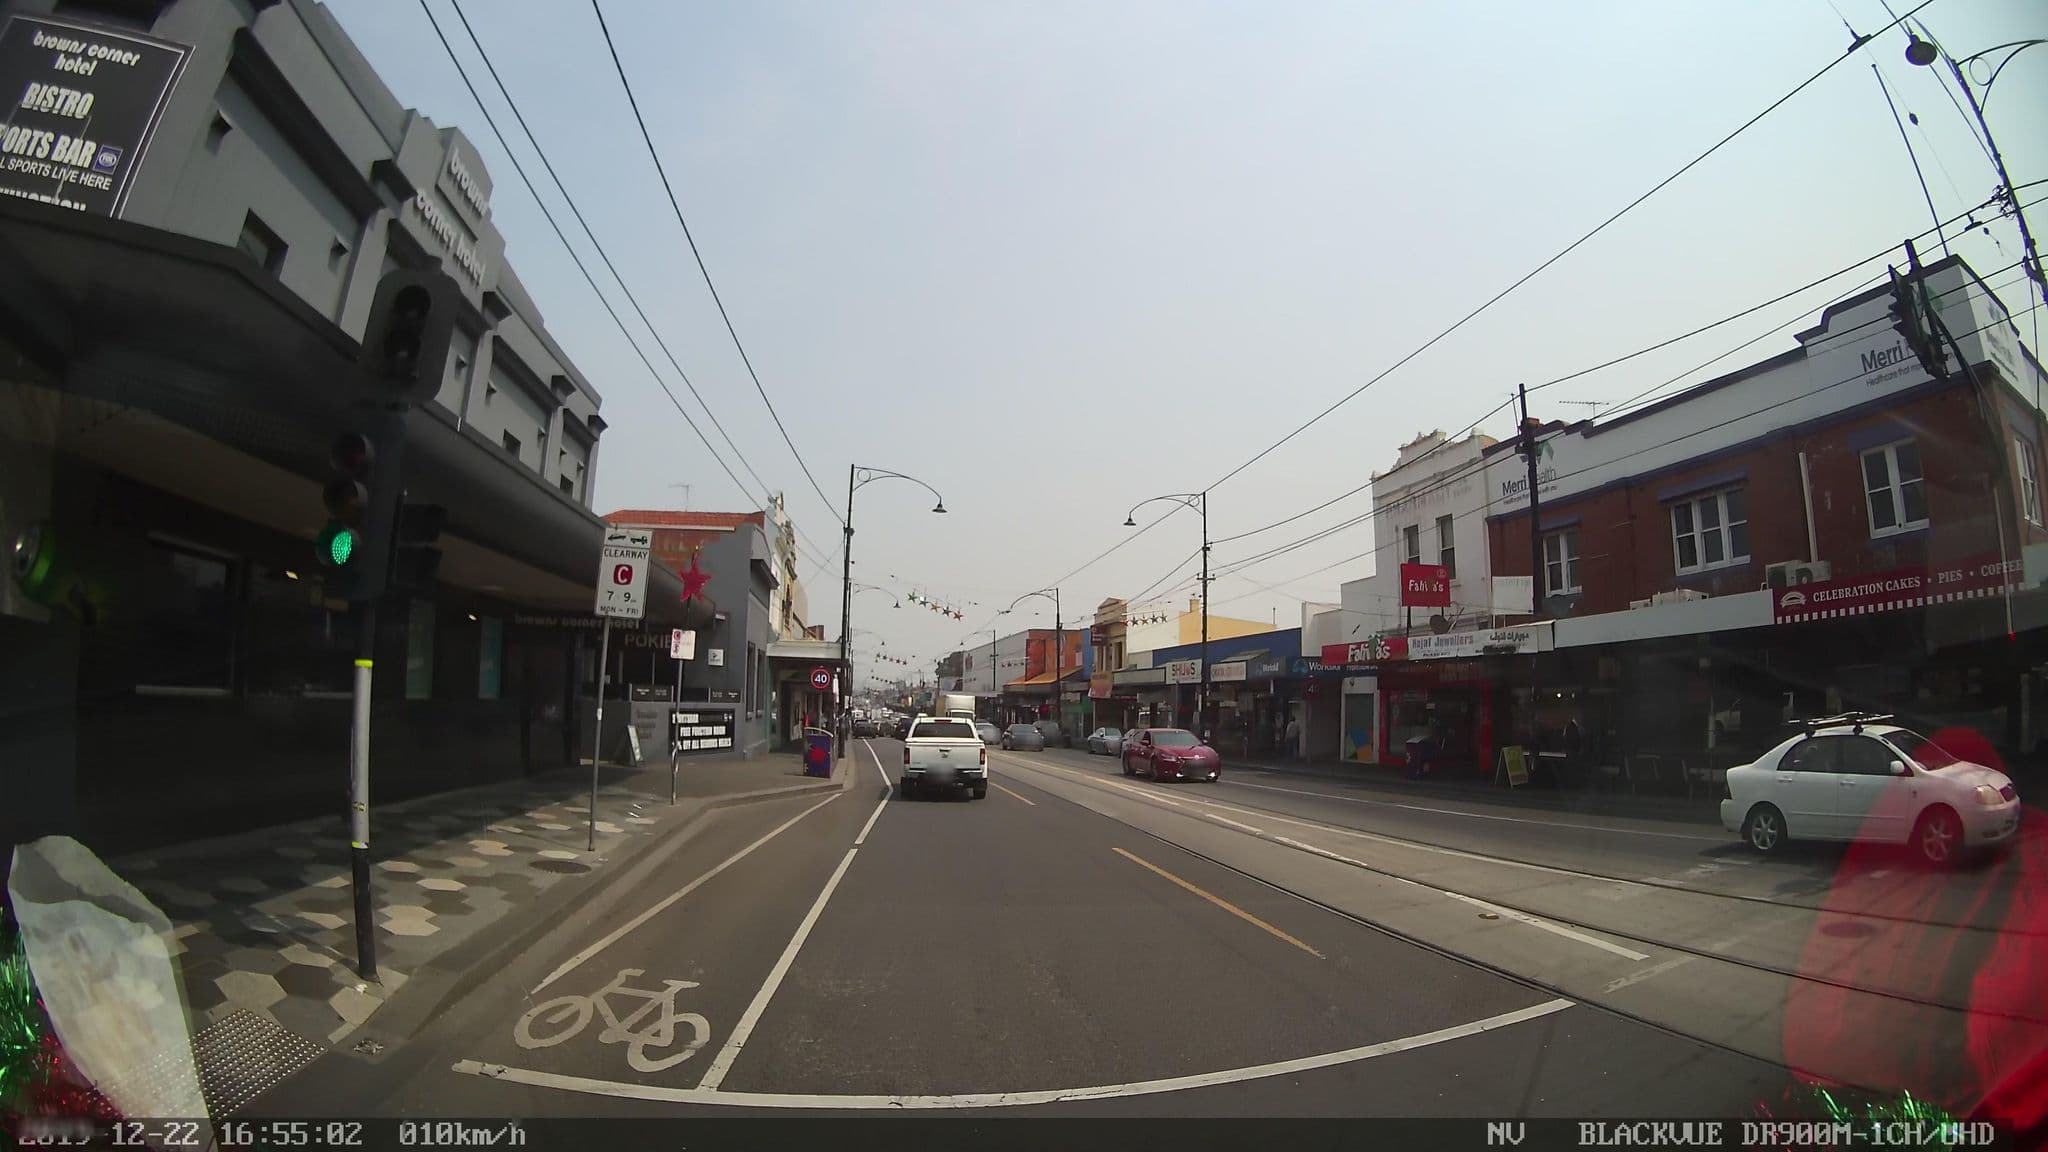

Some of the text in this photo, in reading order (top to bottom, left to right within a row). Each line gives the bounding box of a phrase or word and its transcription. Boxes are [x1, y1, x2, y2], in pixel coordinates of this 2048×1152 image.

[33, 30, 141, 66] browns corner
[54, 54, 98, 76] hotel
[21, 82, 95, 119] BISTRO
[52, 135, 97, 168] BAR
[7, 158, 52, 177] SPORTS
[51, 167, 79, 183] LIVE
[79, 172, 113, 191] HERE
[1861, 340, 1904, 373] Merri
[1502, 475, 1528, 496] Merri
[1536, 466, 1557, 484] ealth
[604, 549, 648, 560] CLEARWAY
[617, 566, 629, 583] C
[1813, 560, 2024, 603] CELEBRATION CAKES PIES COFFEE
[607, 590, 632, 602] 7 9
[1408, 579, 1444, 593] Fahia's
[624, 633, 674, 650] POKIE
[1347, 641, 1391, 662] Fahia's
[814, 673, 828, 683] 40
